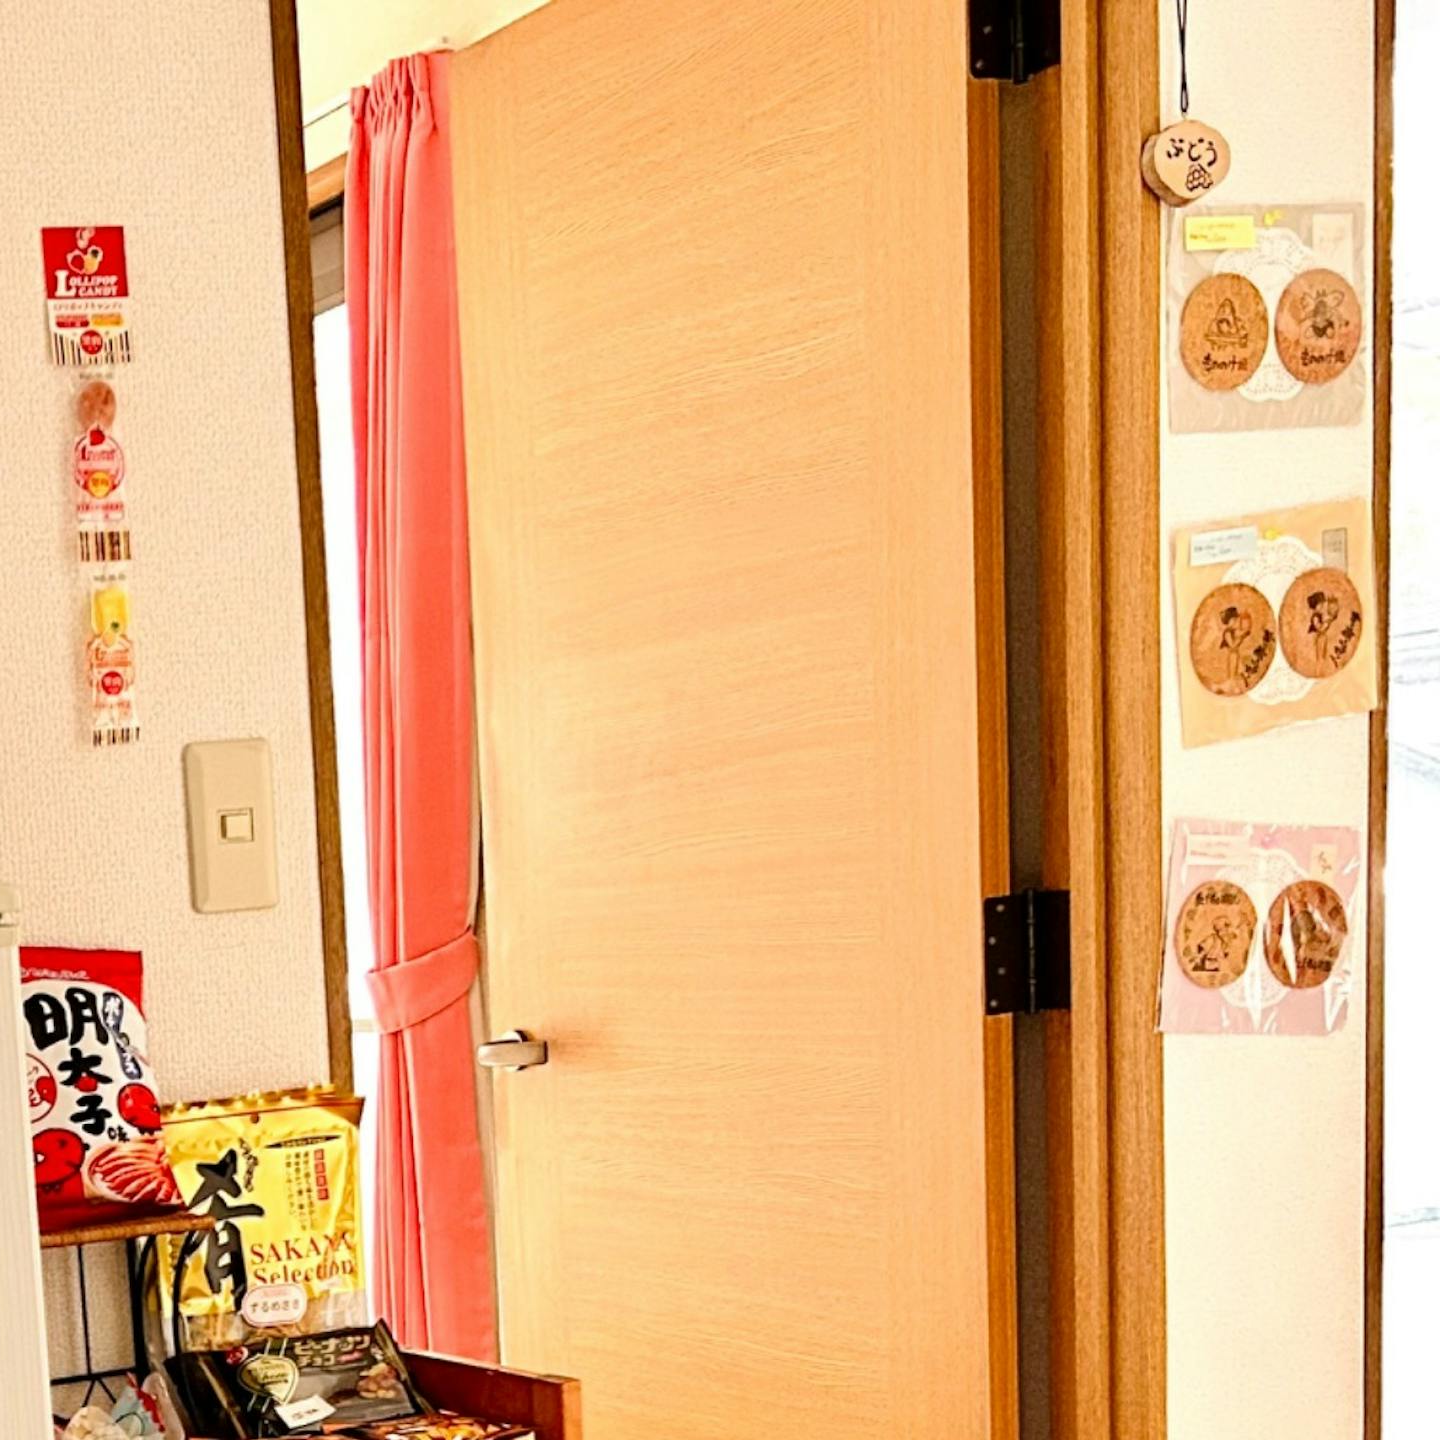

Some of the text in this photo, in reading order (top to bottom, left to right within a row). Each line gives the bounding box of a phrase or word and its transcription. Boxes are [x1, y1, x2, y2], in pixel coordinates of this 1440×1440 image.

[1167, 137, 1218, 167] ぶどう
[253, 1257, 357, 1286] Selection
[293, 1334, 372, 1355] ピーナッツ
[297, 1353, 336, 1367] チョコ
